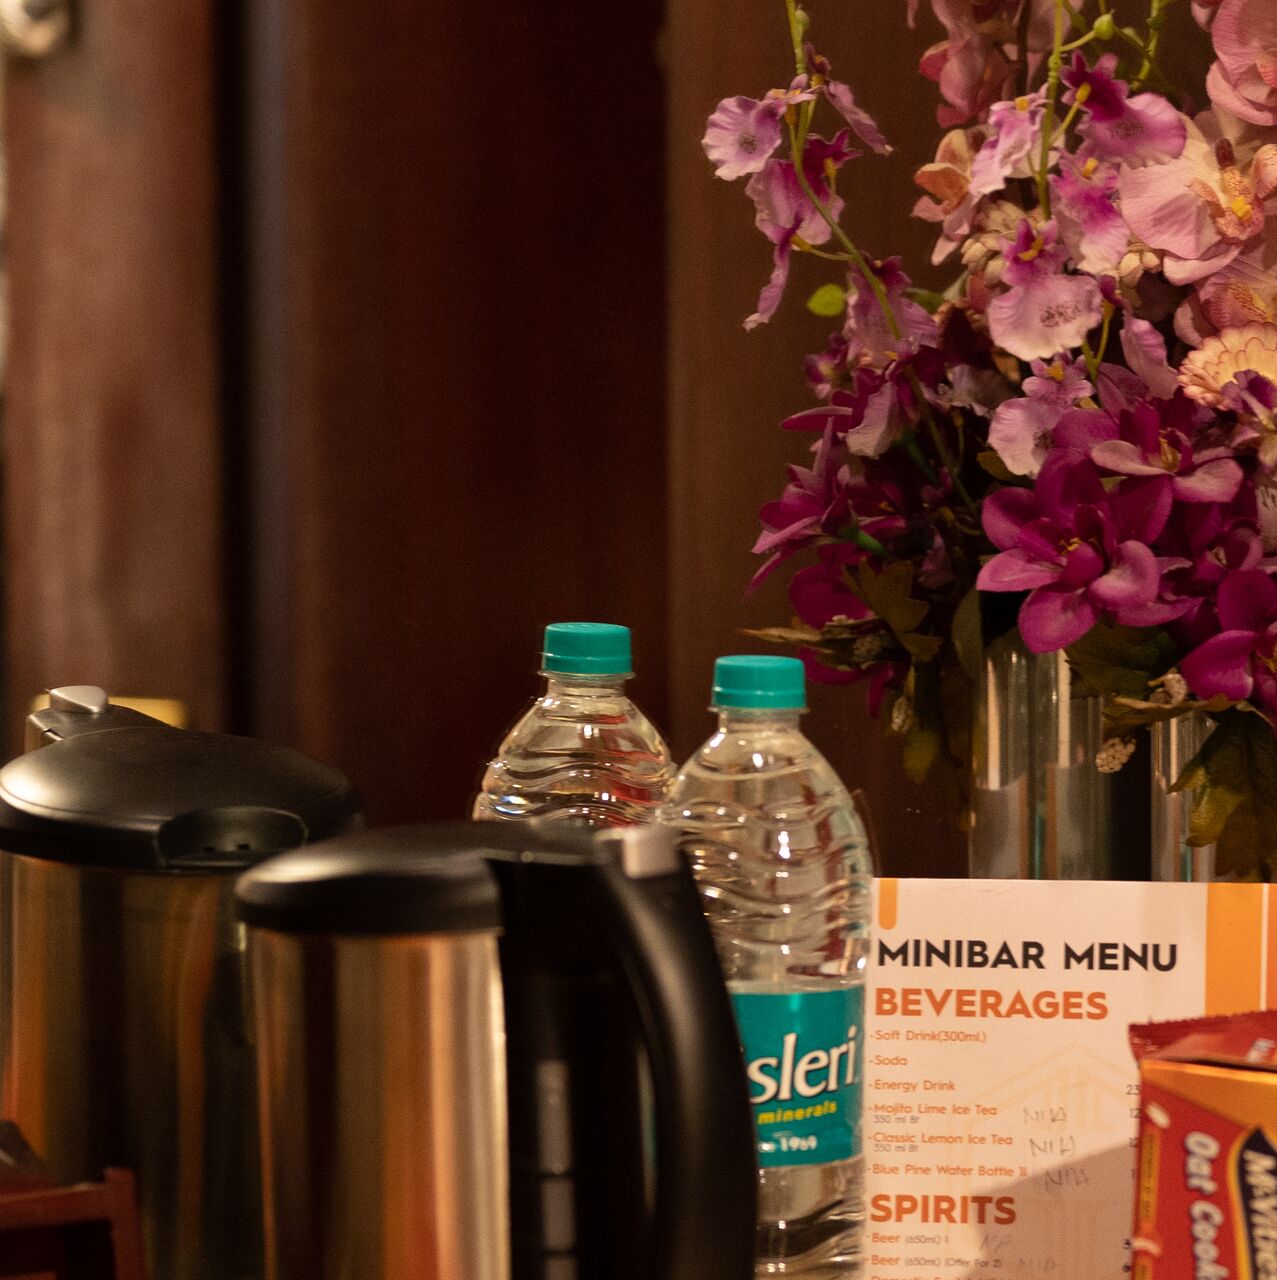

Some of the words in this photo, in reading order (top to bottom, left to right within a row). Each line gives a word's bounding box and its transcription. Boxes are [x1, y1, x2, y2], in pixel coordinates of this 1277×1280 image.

[878, 939, 1046, 970] MINIBAR
[1063, 941, 1178, 972] MENU
[874, 987, 1109, 1020] BEVERAGES
[874, 1029, 901, 1041] Soft
[746, 1024, 856, 1104] sleri
[874, 1054, 908, 1066] Soda
[874, 1079, 918, 1093] Energy
[923, 1080, 956, 1091] Drink
[757, 1100, 837, 1124] minerals
[873, 1103, 913, 1116] Mojito
[917, 1104, 946, 1115] Lime
[951, 1104, 970, 1115] Ice
[975, 1105, 998, 1115] Tea
[872, 1132, 916, 1144] Classic
[921, 1133, 962, 1145] Lemon
[968, 1134, 986, 1145] Ice
[991, 1135, 1013, 1145] Tea
[1184, 1130, 1220, 1195] Oat
[872, 1163, 899, 1175] Blue
[905, 1164, 931, 1175] Pine
[936, 1165, 973, 1176] Water
[978, 1166, 1014, 1177] Bottle
[870, 1193, 1017, 1225] SPIRITS
[871, 1232, 900, 1244] Beer
[871, 1254, 900, 1266] Beer
